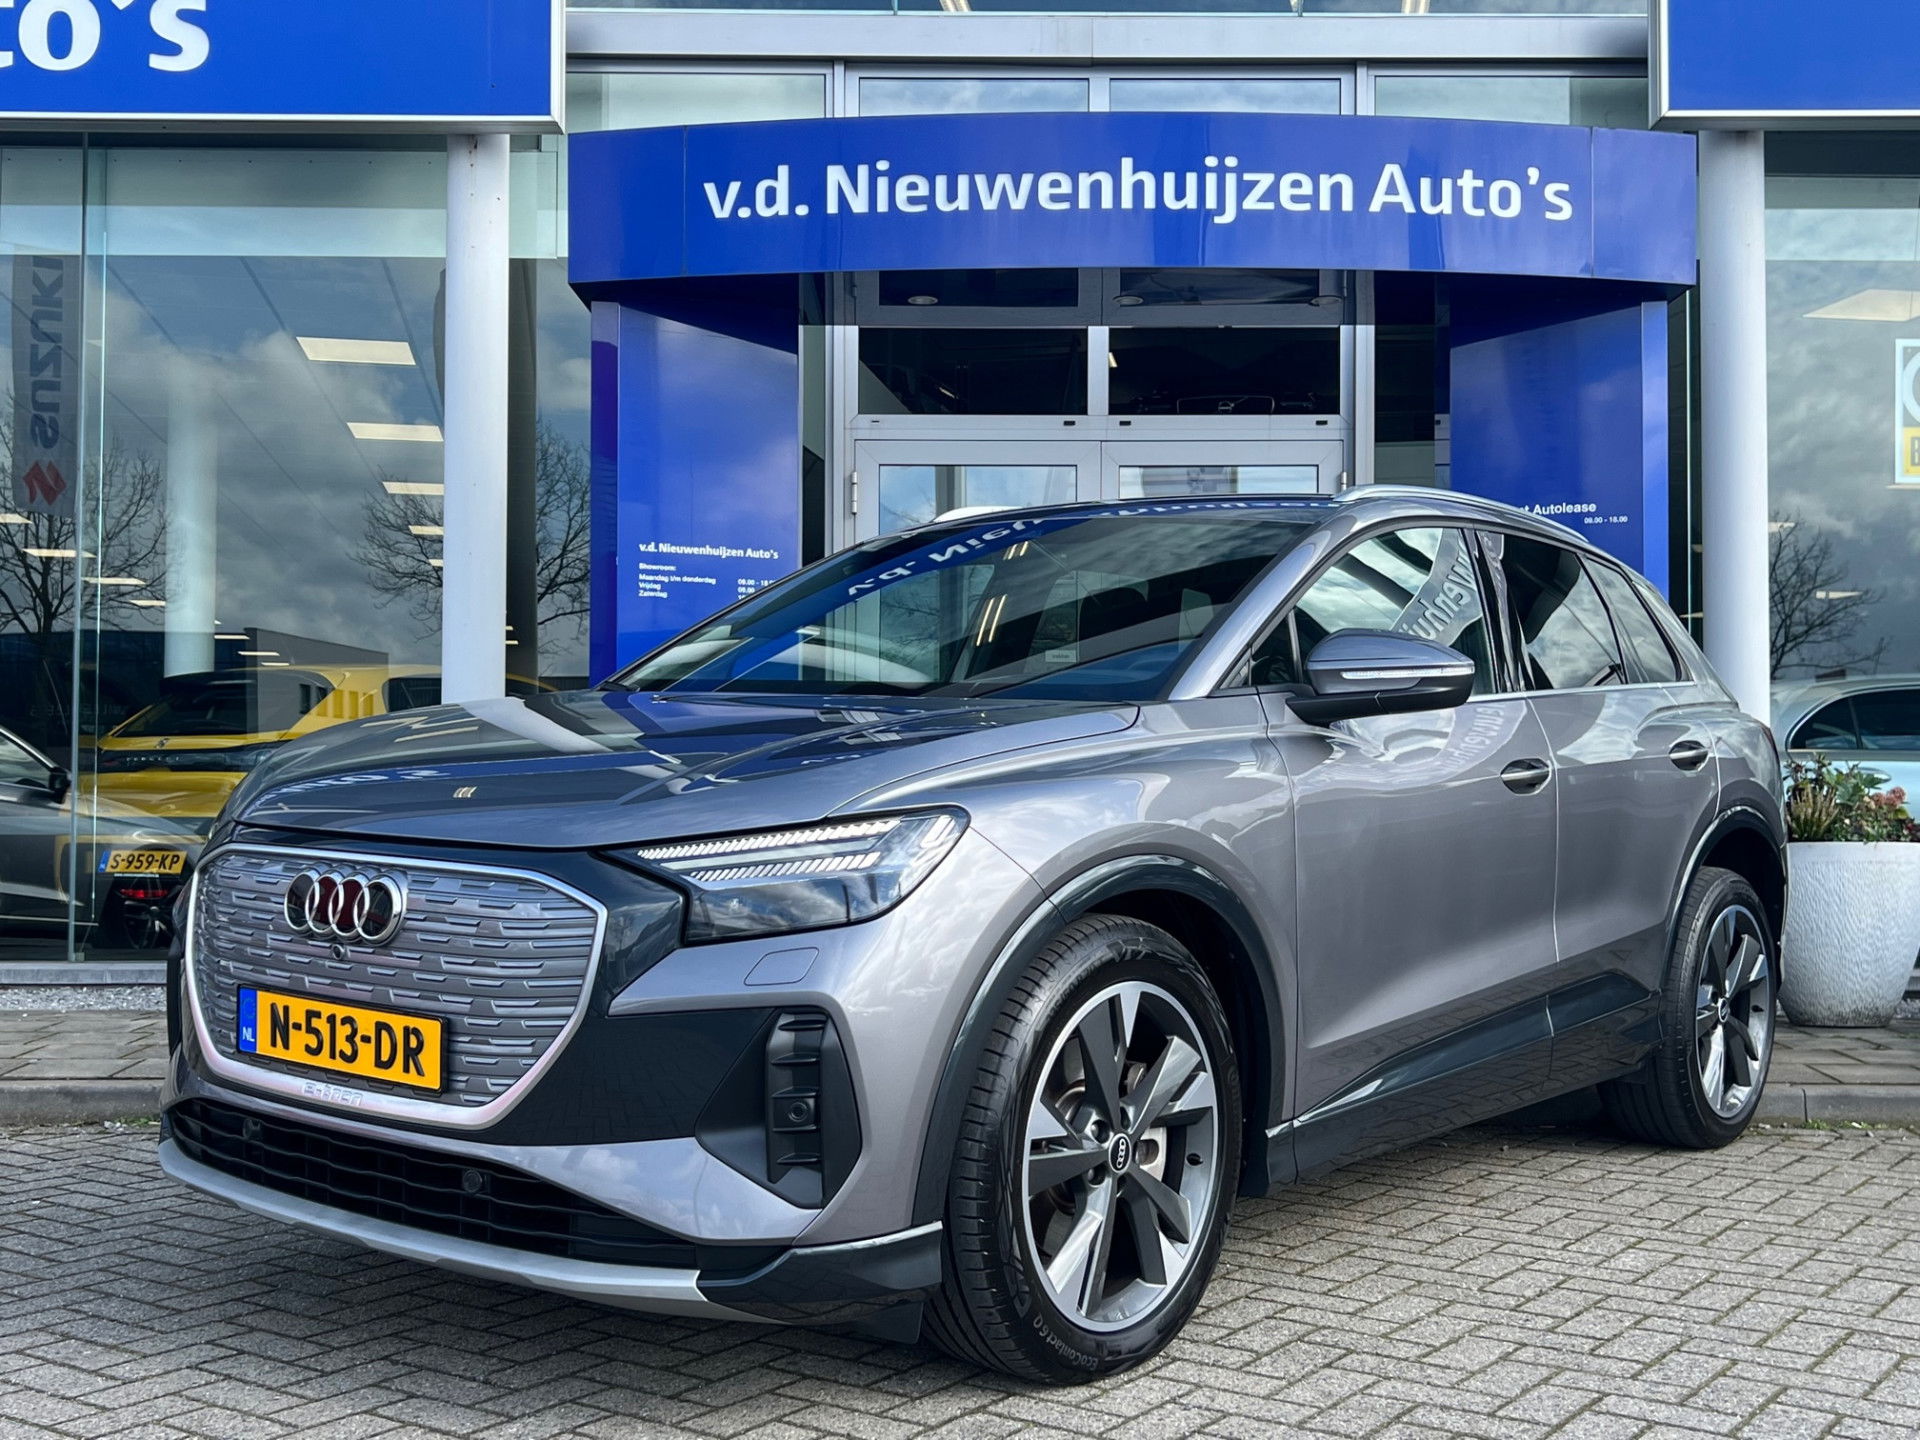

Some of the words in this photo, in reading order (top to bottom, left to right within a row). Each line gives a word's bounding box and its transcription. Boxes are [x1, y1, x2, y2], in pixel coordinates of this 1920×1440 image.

[703, 165, 810, 218] v.d.
[826, 156, 1354, 224] Nieuwenhuijzen
[1368, 163, 1574, 221] Auto's
[1533, 502, 1597, 514] Autolease
[639, 542, 657, 552] v.d.
[658, 543, 744, 558] Nieuwenhuijzen
[745, 548, 779, 559] Auto's
[110, 853, 181, 871] S-959-KP
[242, 1026, 255, 1043] NL
[269, 1002, 425, 1078] N-513-DR
